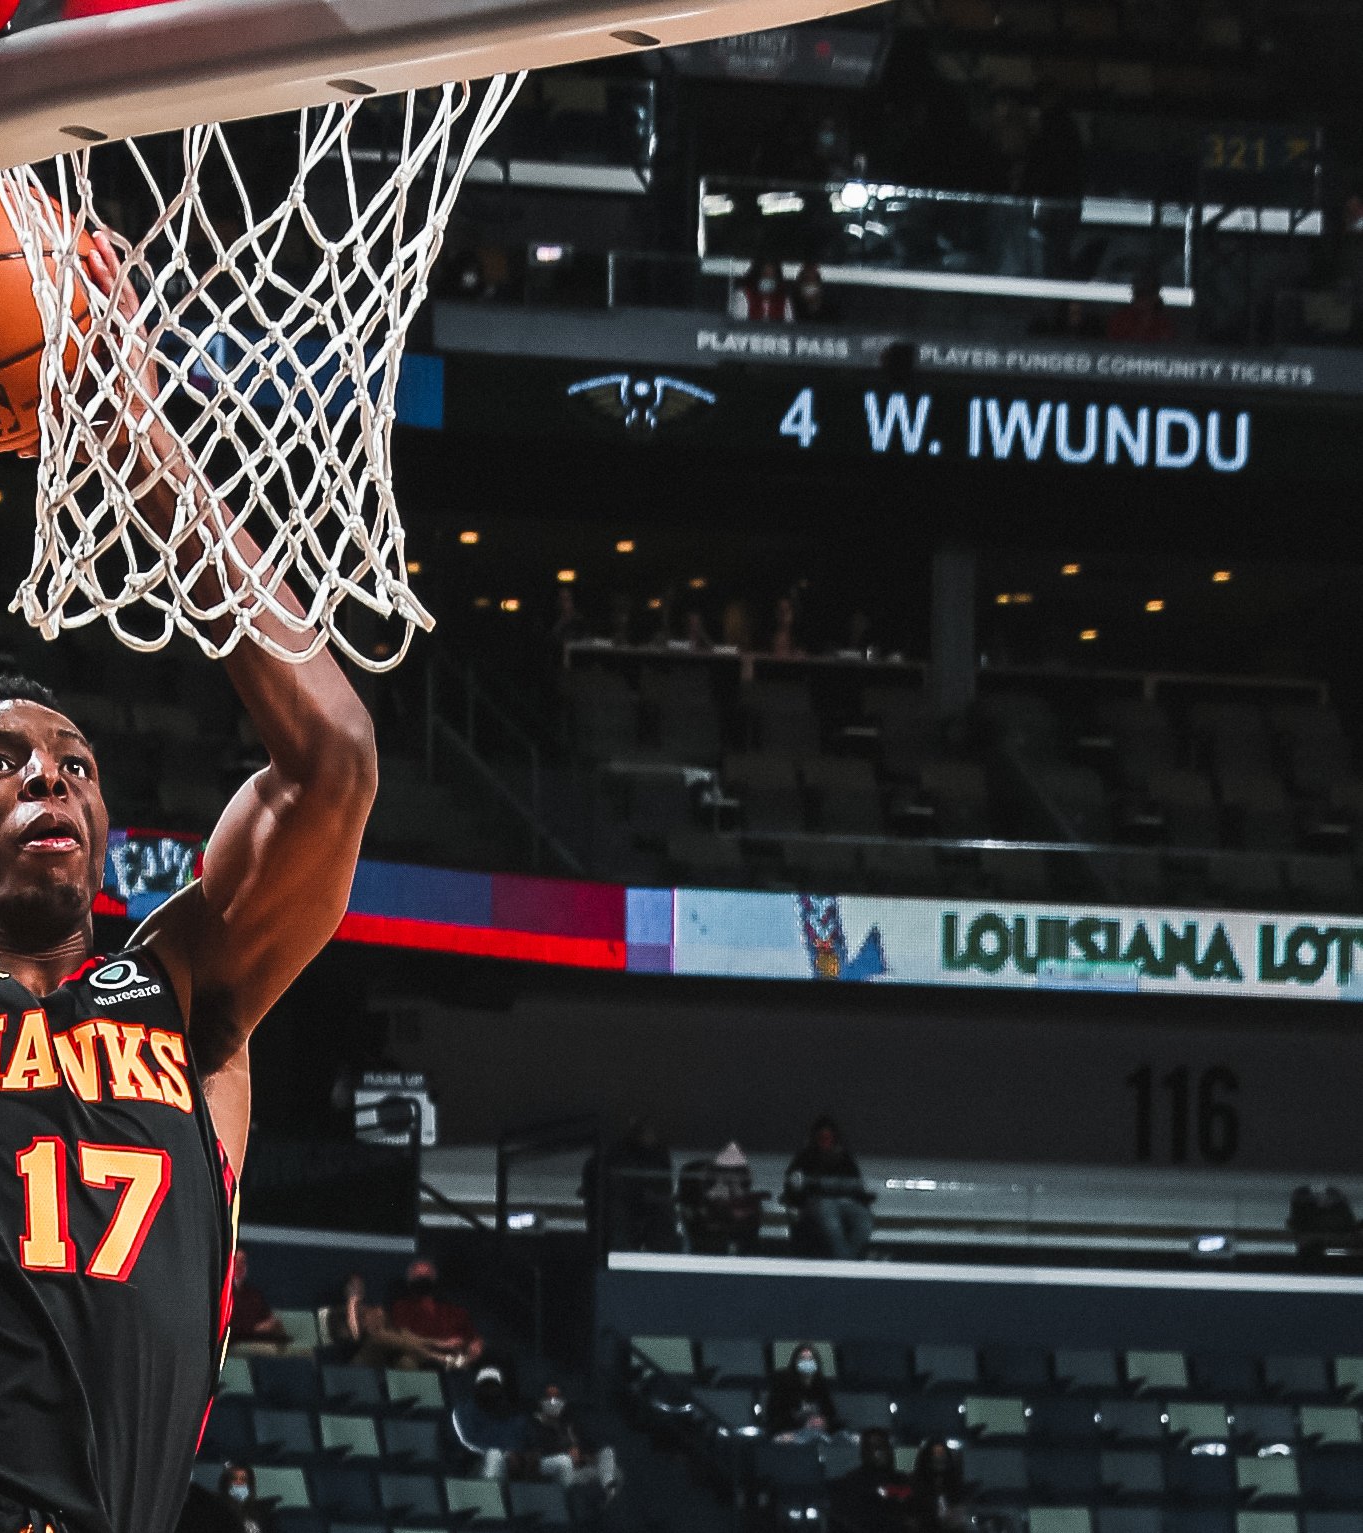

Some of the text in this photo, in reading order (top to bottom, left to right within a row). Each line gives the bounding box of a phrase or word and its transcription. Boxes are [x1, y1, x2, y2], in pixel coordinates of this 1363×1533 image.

[696, 331, 791, 356] PLAYERS
[794, 336, 849, 359] PASS
[1096, 354, 1224, 381] COMMUNITY
[1230, 361, 1314, 386] TICKETS
[779, 387, 1250, 472] 4 W. IWUNDU
[942, 911, 1246, 983] LOUISIANA
[1126, 1064, 1240, 1164] 116
[15, 1136, 170, 1283] 17
